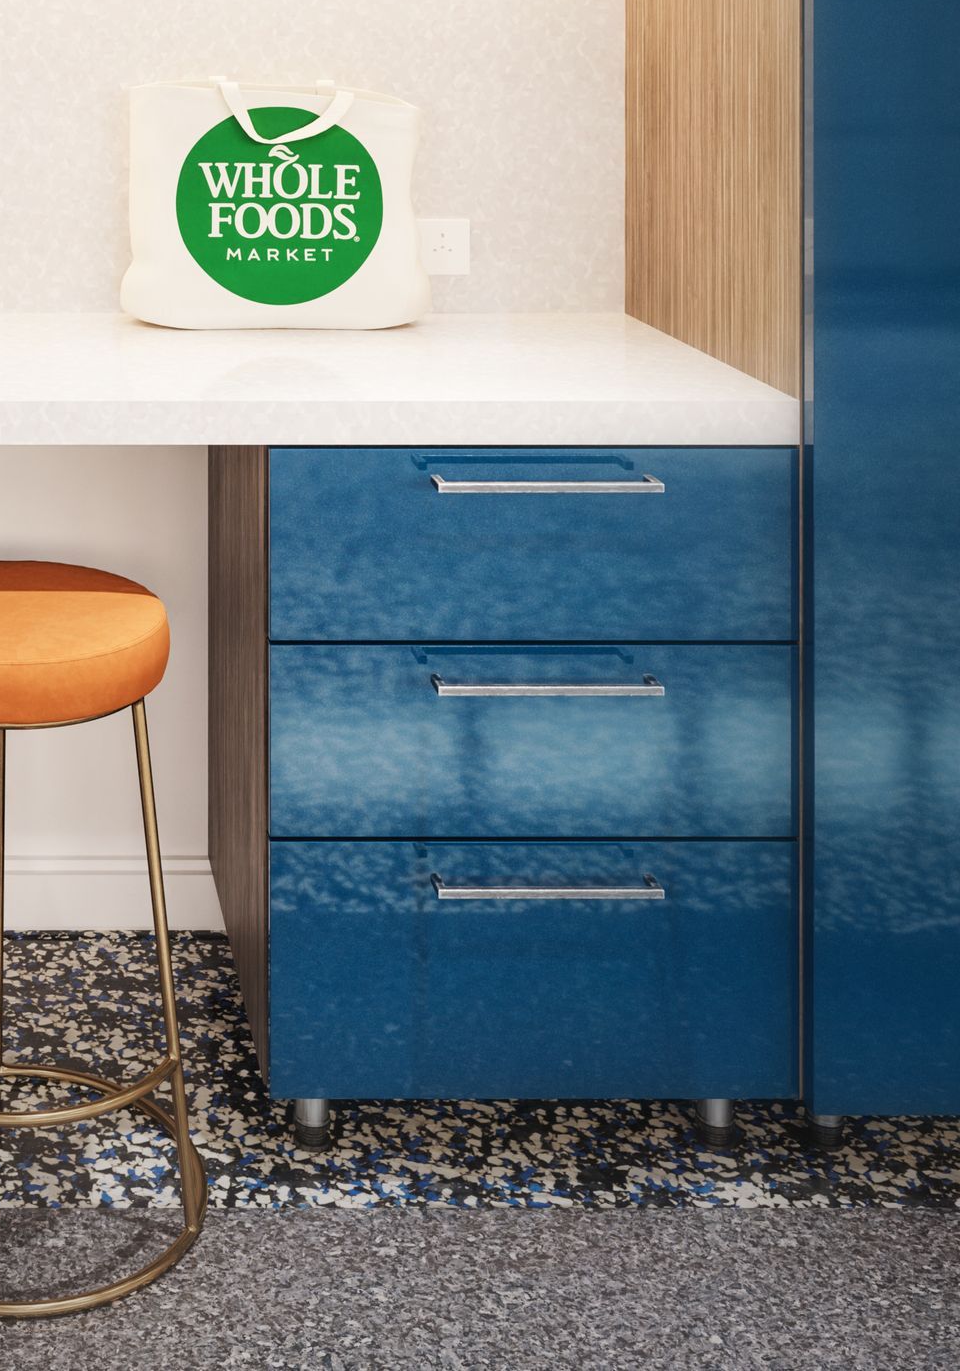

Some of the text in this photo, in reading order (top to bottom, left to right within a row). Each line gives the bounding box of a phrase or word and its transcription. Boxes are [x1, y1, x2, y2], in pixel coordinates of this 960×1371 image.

[198, 155, 361, 200] WHOLE
[208, 202, 357, 241] FOODS
[226, 248, 333, 262] MARKET
